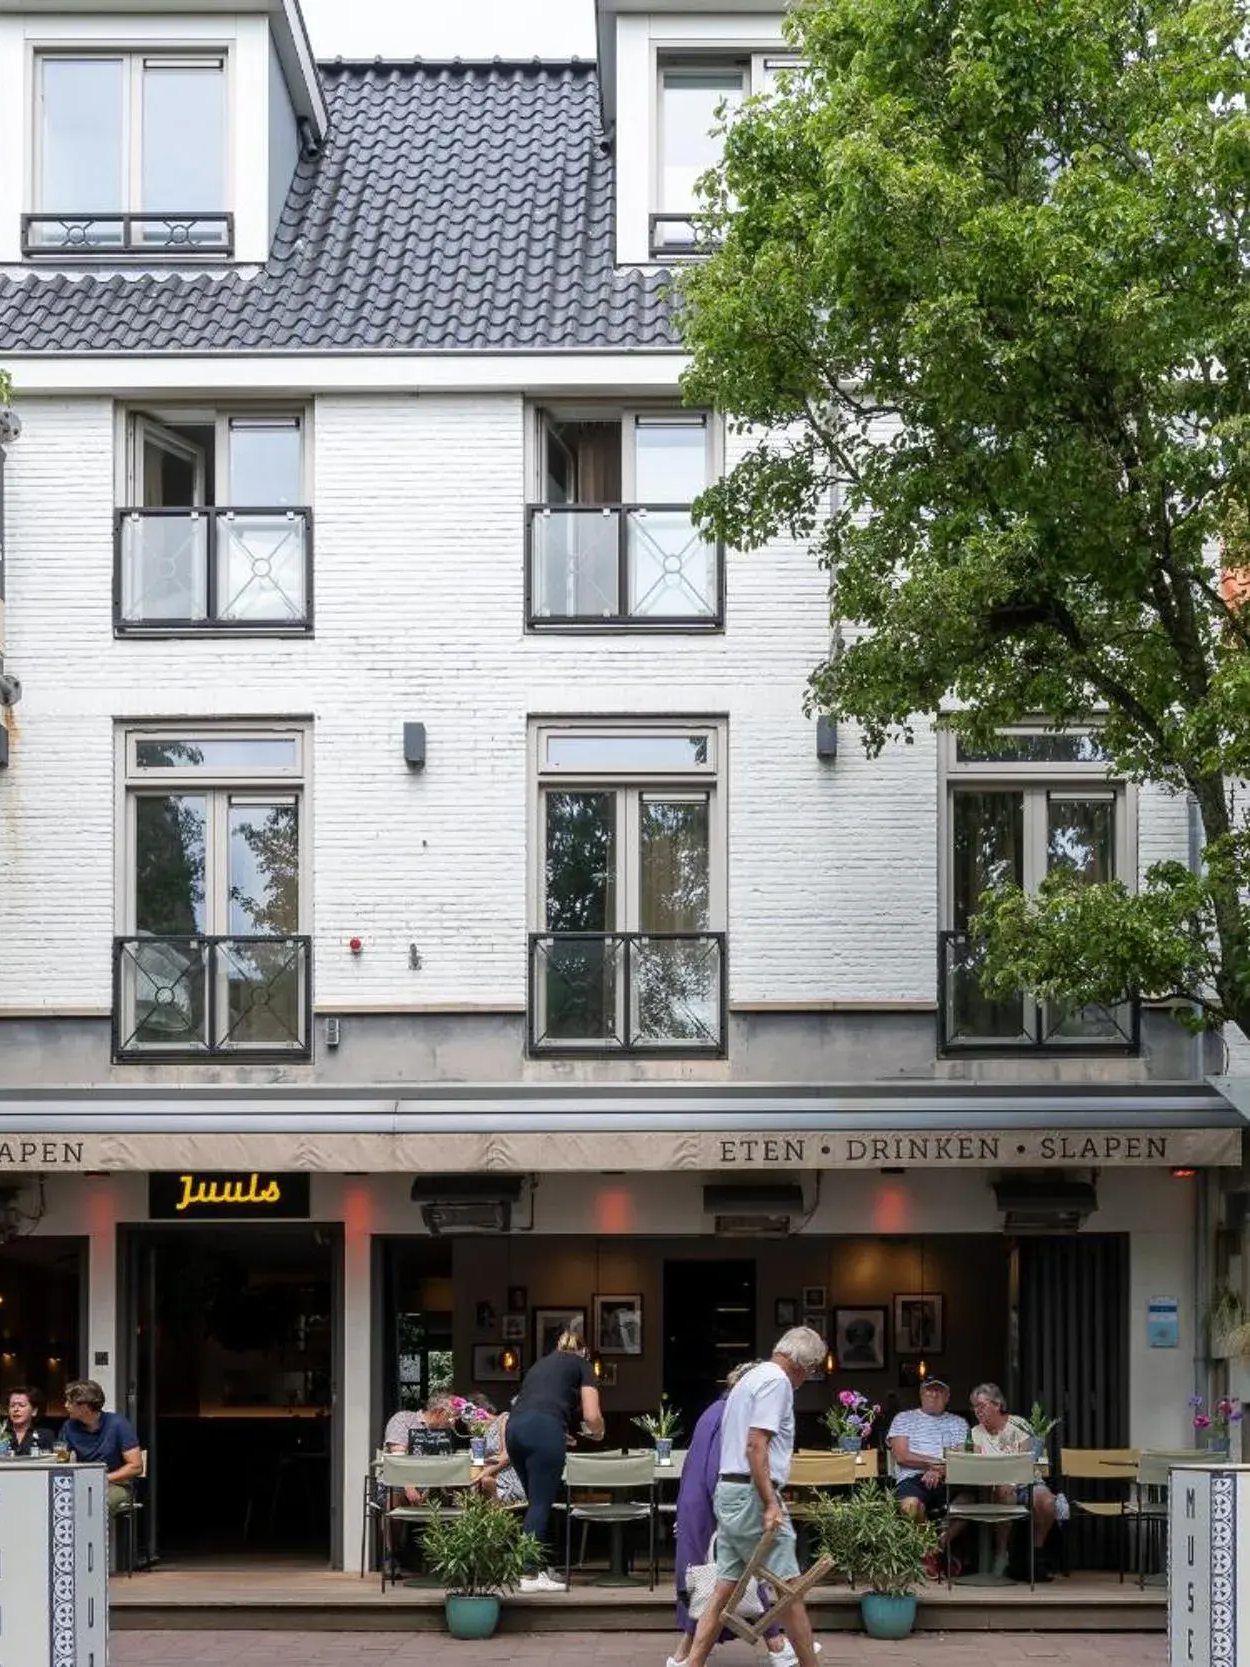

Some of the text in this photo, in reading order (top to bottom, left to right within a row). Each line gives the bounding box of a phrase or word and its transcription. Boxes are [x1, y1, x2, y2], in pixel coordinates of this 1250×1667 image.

[720, 1137, 1168, 1162] ETEN DRINKEN SLAPEN
[176, 1173, 280, 1210] Juuls
